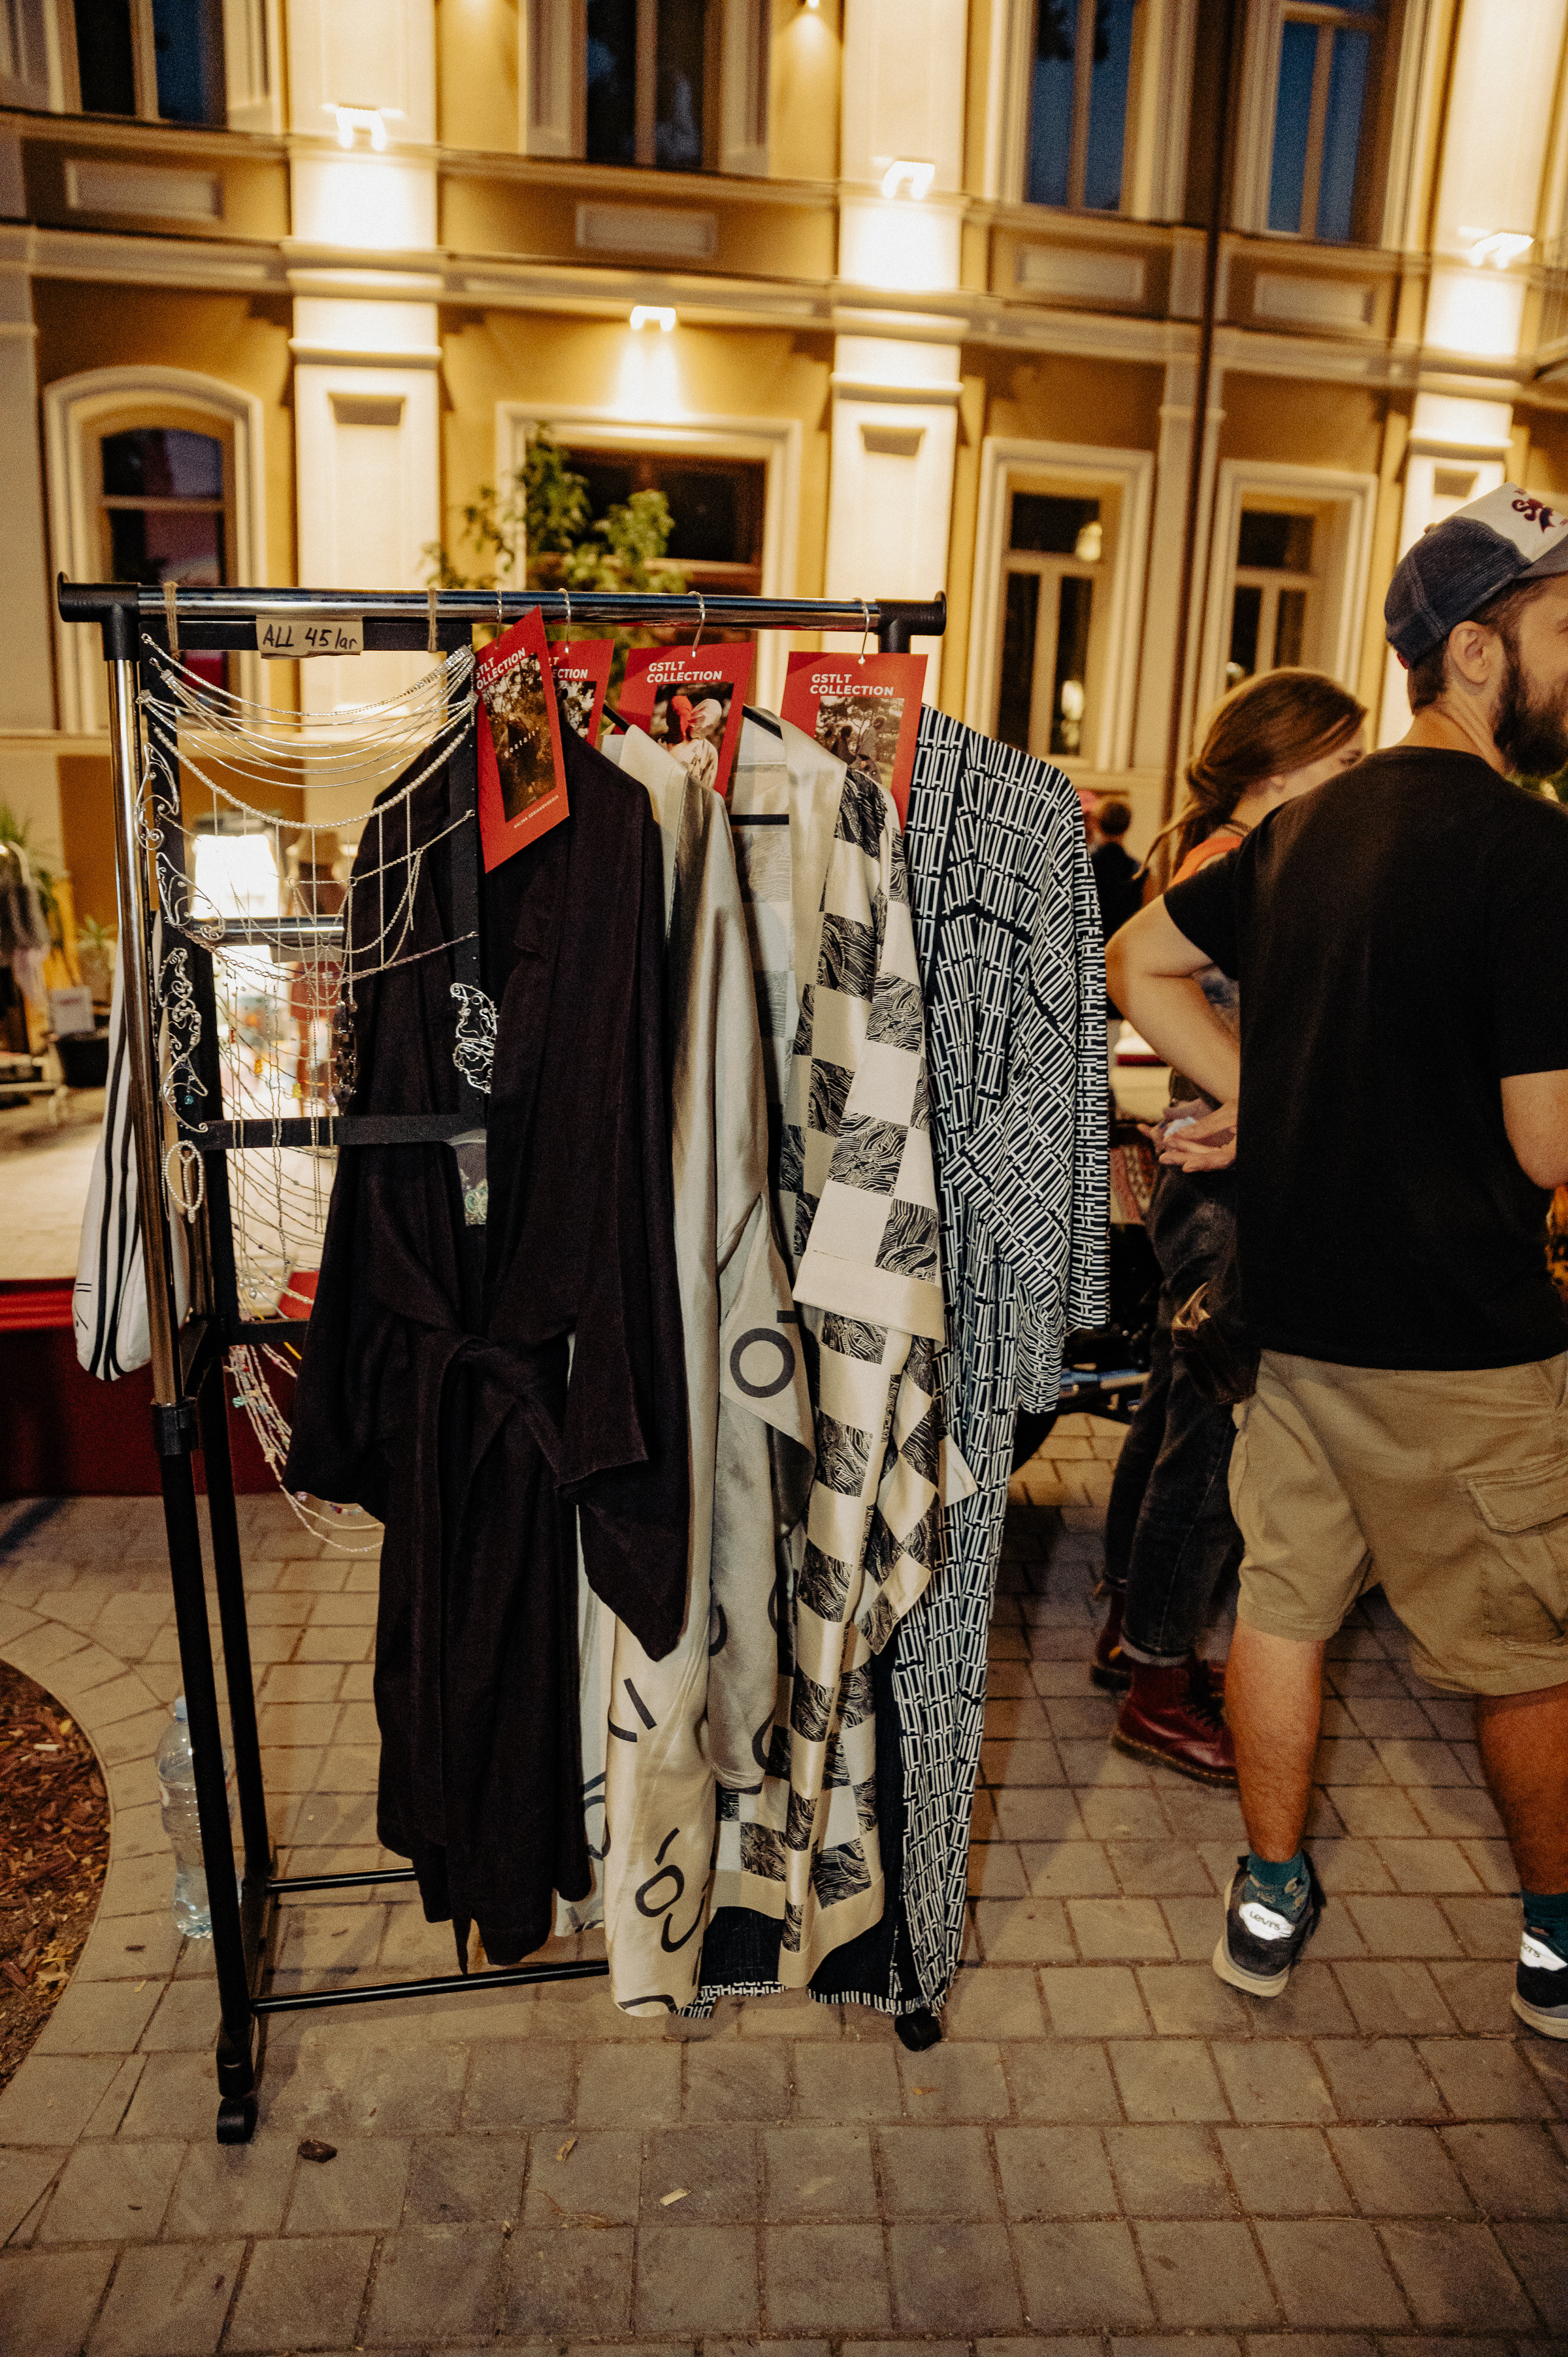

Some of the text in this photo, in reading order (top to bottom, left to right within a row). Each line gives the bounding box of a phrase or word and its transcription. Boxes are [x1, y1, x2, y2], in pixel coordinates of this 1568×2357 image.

[263, 623, 294, 648] ALL
[476, 657, 495, 679] STLT
[476, 647, 526, 690] OLLECTION
[649, 661, 685, 672] GSTLT
[646, 670, 722, 684] COLLECTION
[811, 673, 852, 684] GSTLT
[809, 684, 894, 696] COLLECTION
